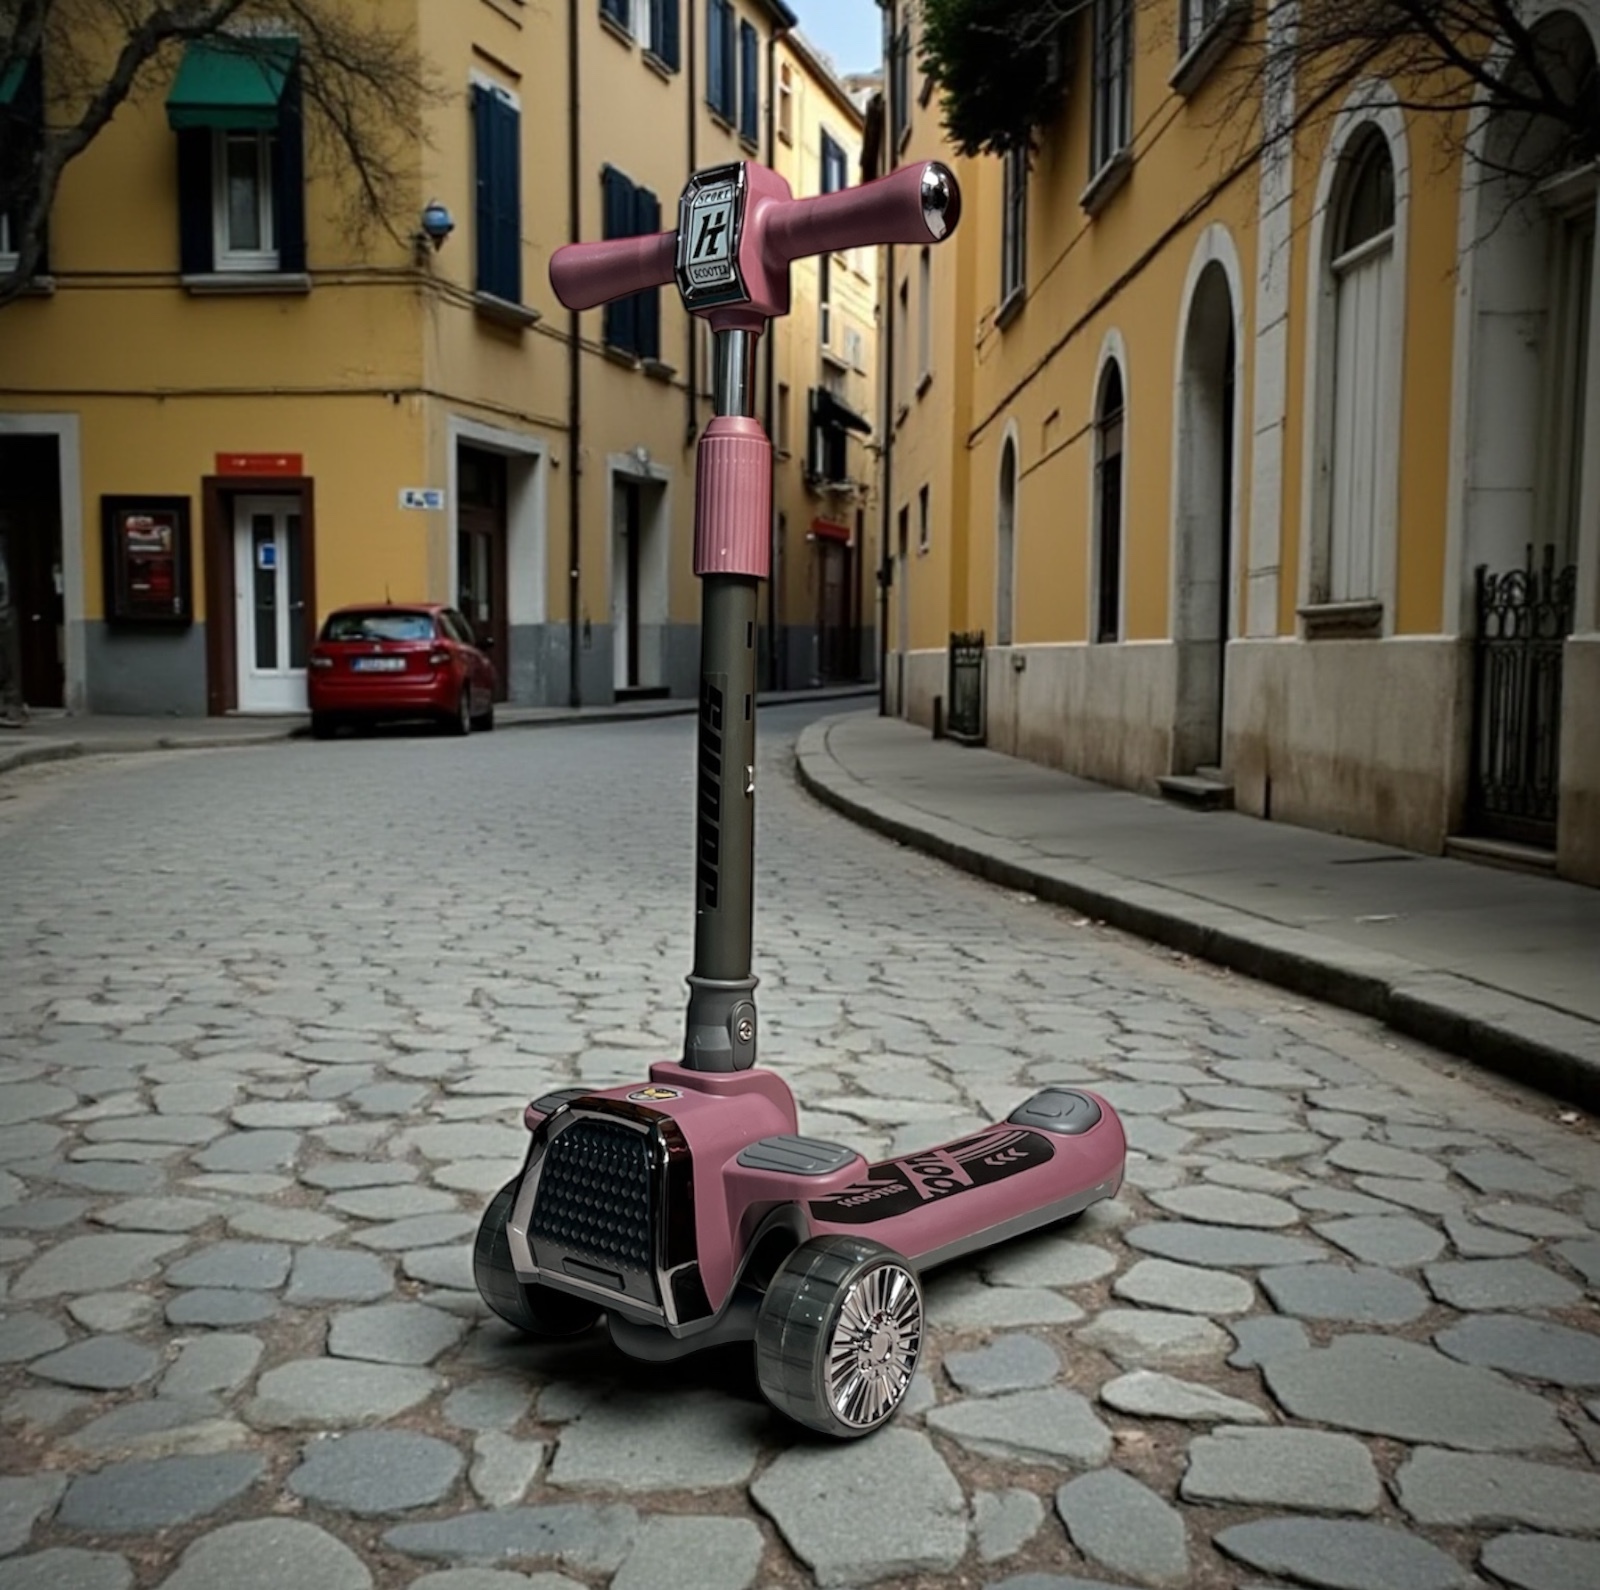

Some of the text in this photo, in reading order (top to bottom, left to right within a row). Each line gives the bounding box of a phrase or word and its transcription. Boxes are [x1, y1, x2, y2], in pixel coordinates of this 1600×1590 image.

[699, 189, 729, 204] SPORT
[693, 264, 729, 279] SCOOTER
[838, 1184, 908, 1207] SCOOTER
